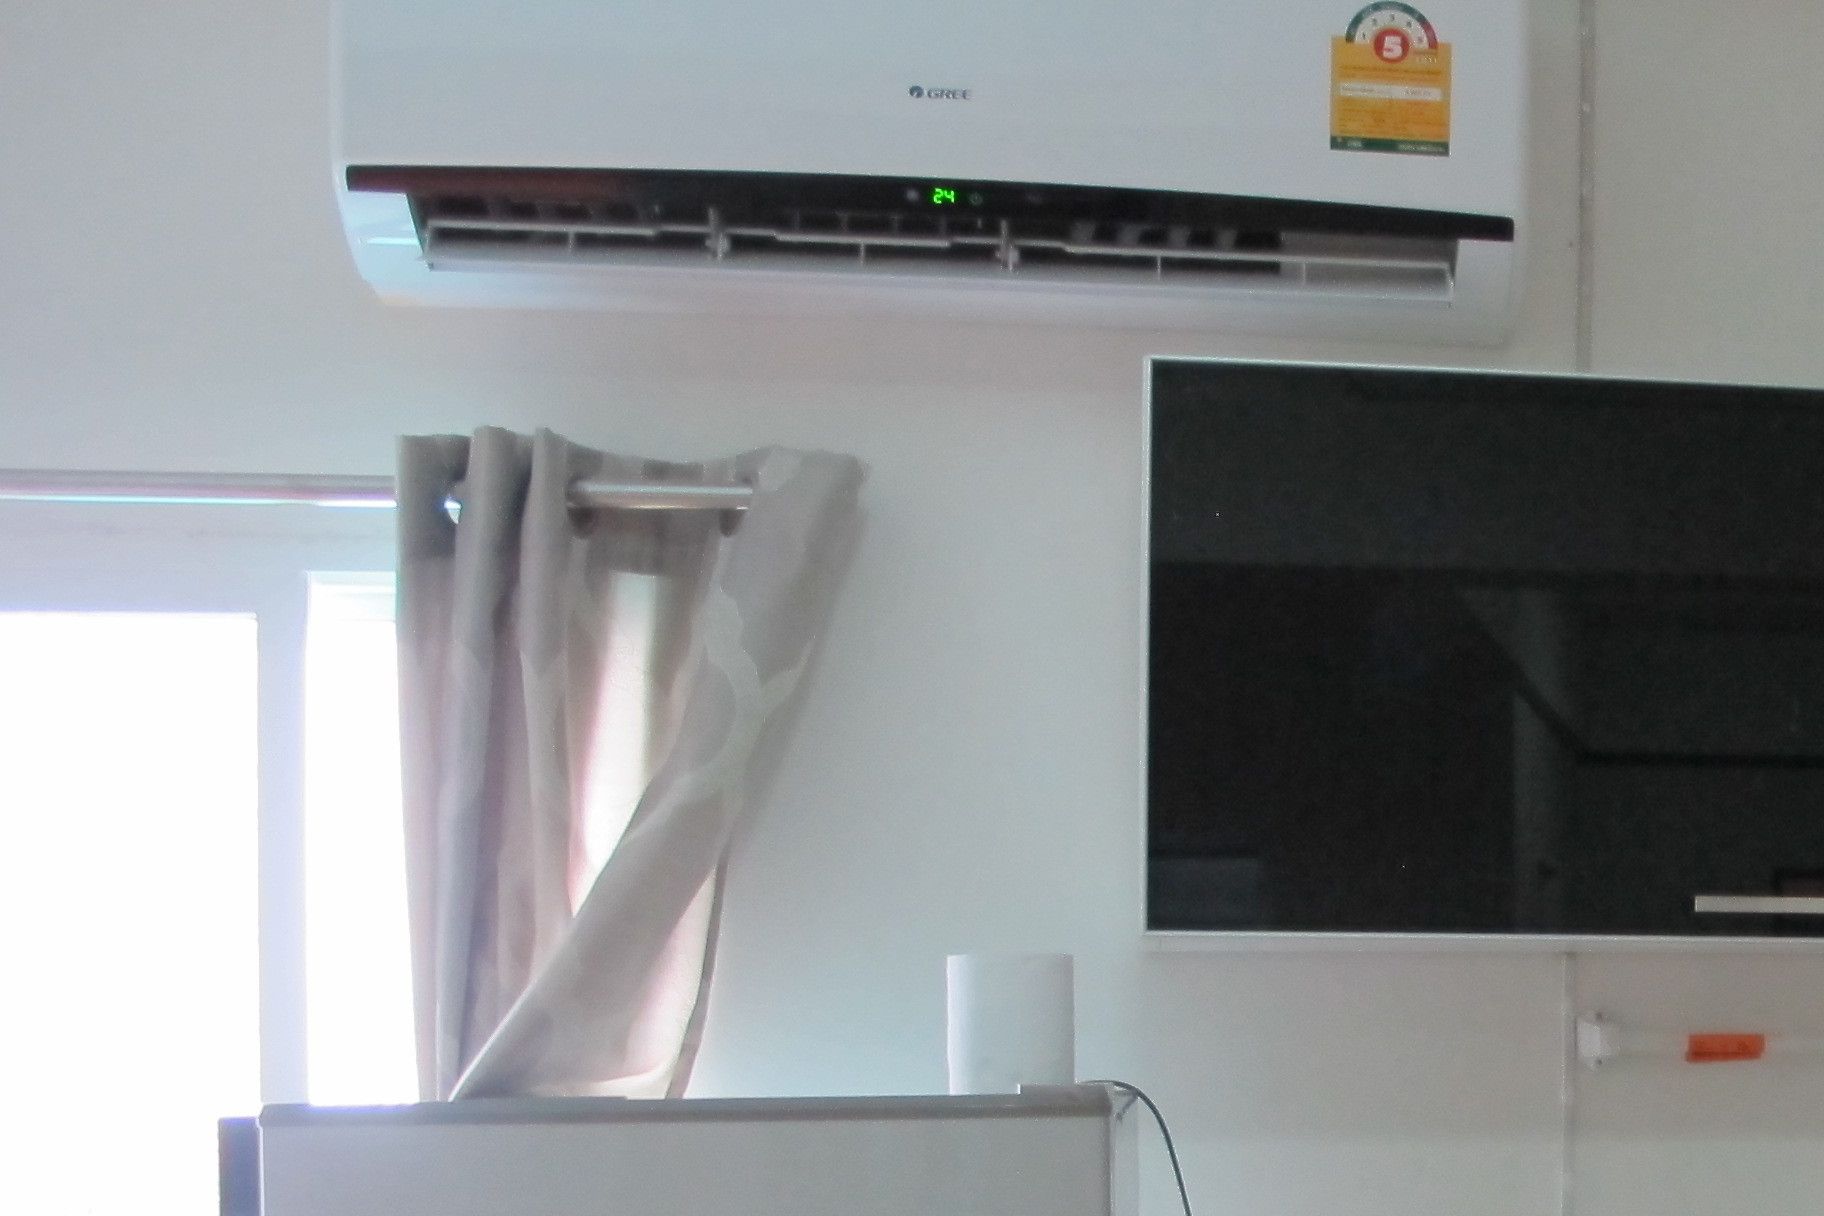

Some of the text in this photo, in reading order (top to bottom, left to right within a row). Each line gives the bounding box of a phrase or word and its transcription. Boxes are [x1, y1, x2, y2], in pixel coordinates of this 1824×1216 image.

[1382, 34, 1404, 60] 5
[926, 87, 972, 100] GREE
[933, 187, 955, 204] 24
